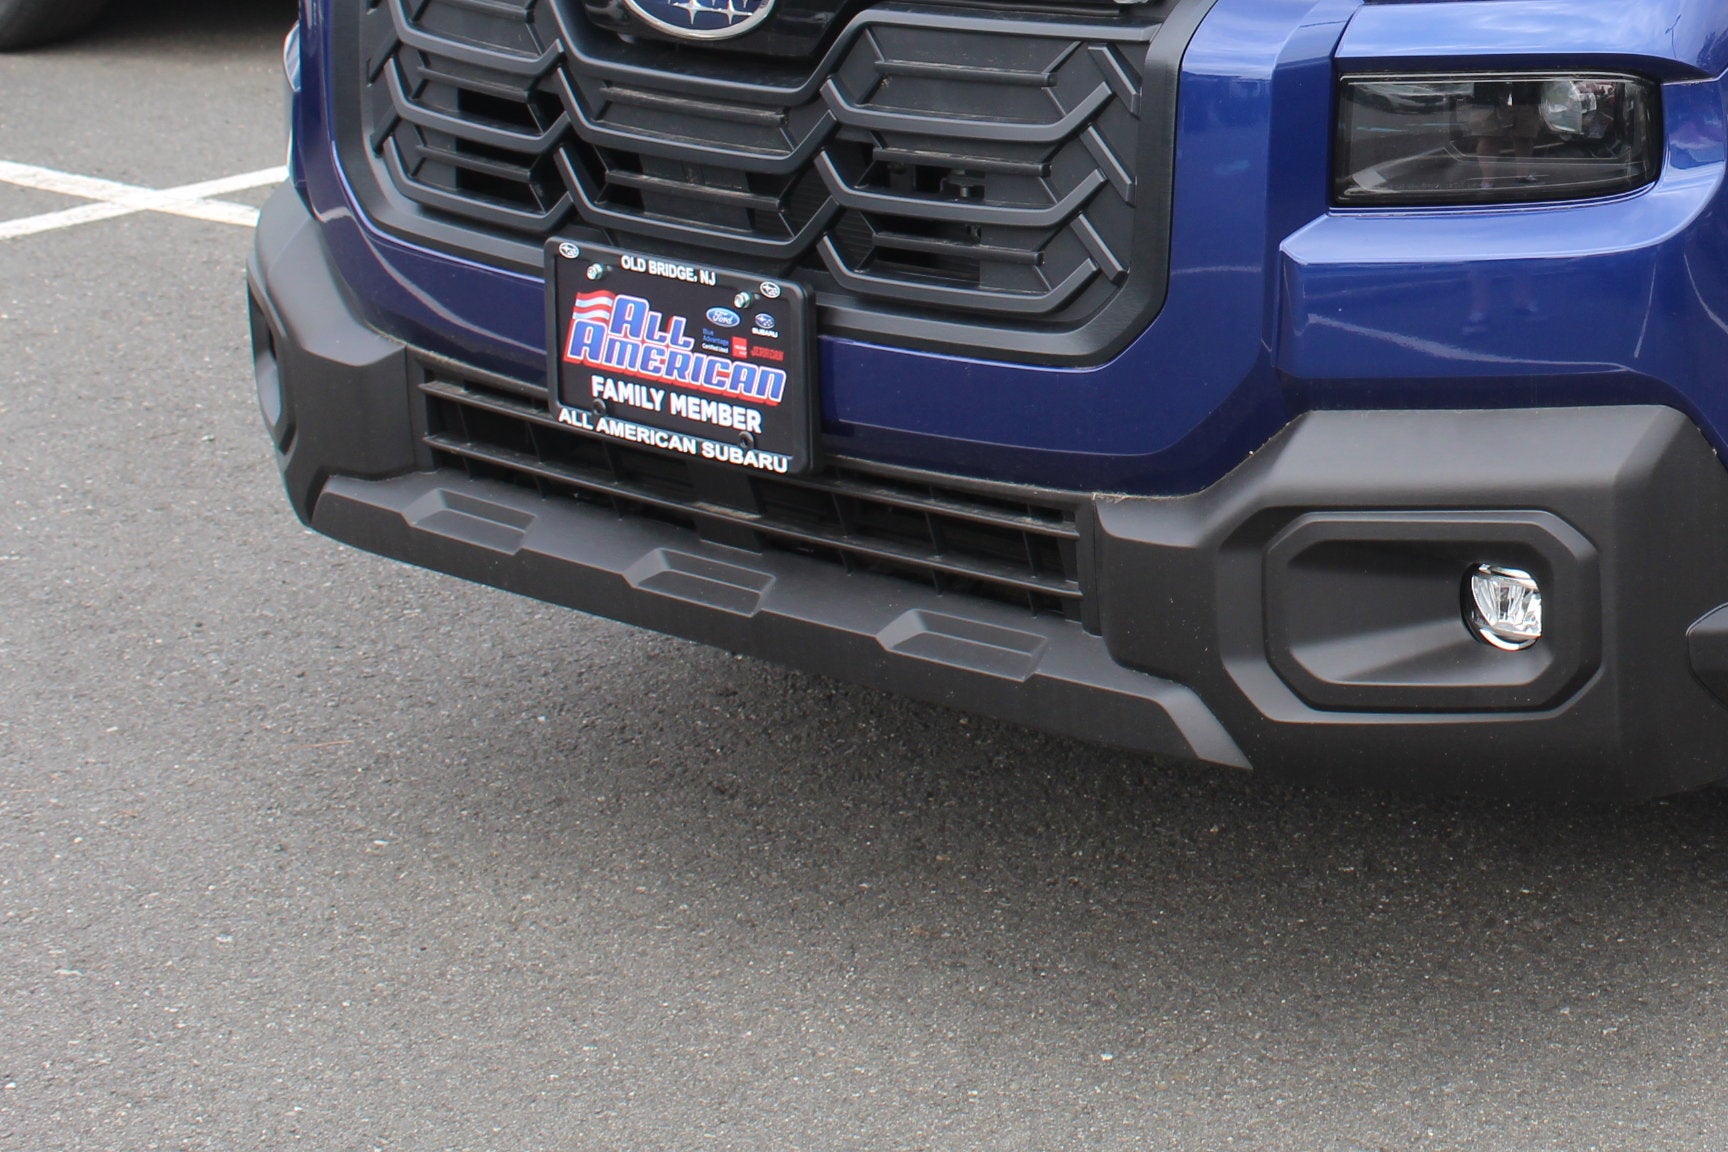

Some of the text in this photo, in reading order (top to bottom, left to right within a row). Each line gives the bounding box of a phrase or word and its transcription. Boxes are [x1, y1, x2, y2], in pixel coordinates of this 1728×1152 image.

[620, 254, 717, 287] OLD BRIDGE, NJ
[607, 294, 695, 351] ALL
[712, 310, 735, 325] Ford
[751, 327, 779, 339] SUBARU
[591, 374, 763, 434] FAMILY MEMBER
[558, 407, 789, 474] ALL AMERICAN SUBARU
